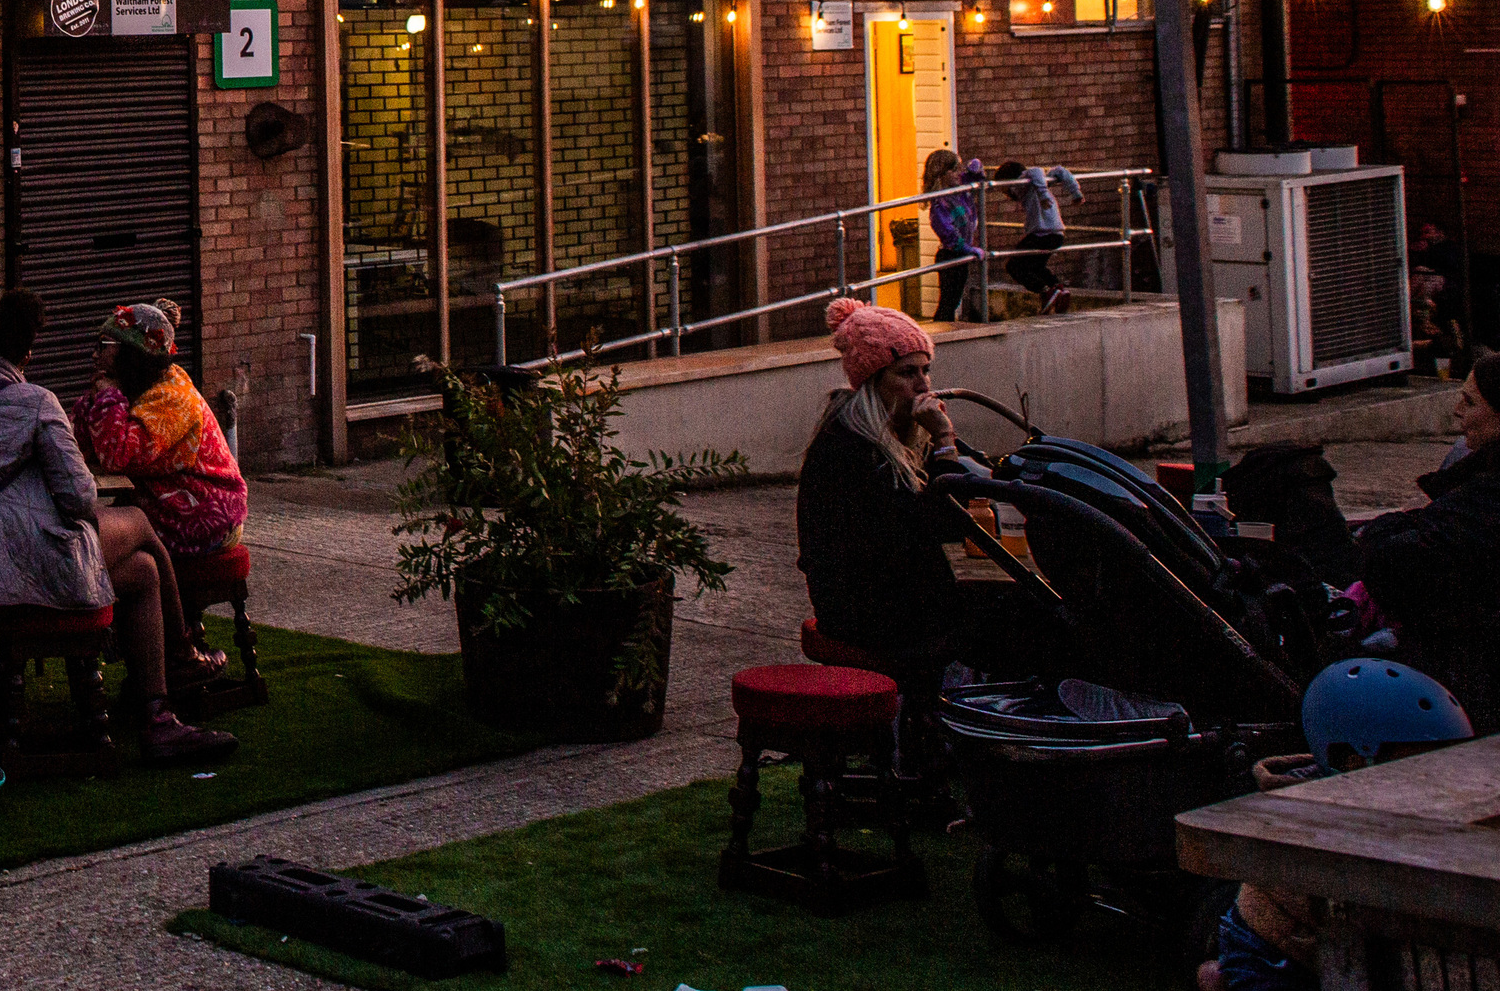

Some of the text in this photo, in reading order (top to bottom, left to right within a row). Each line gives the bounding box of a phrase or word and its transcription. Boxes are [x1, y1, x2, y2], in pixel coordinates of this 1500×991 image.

[59, 5, 85, 22] BREWING
[115, 6, 160, 16] Services Ltd
[240, 26, 254, 58] 2
